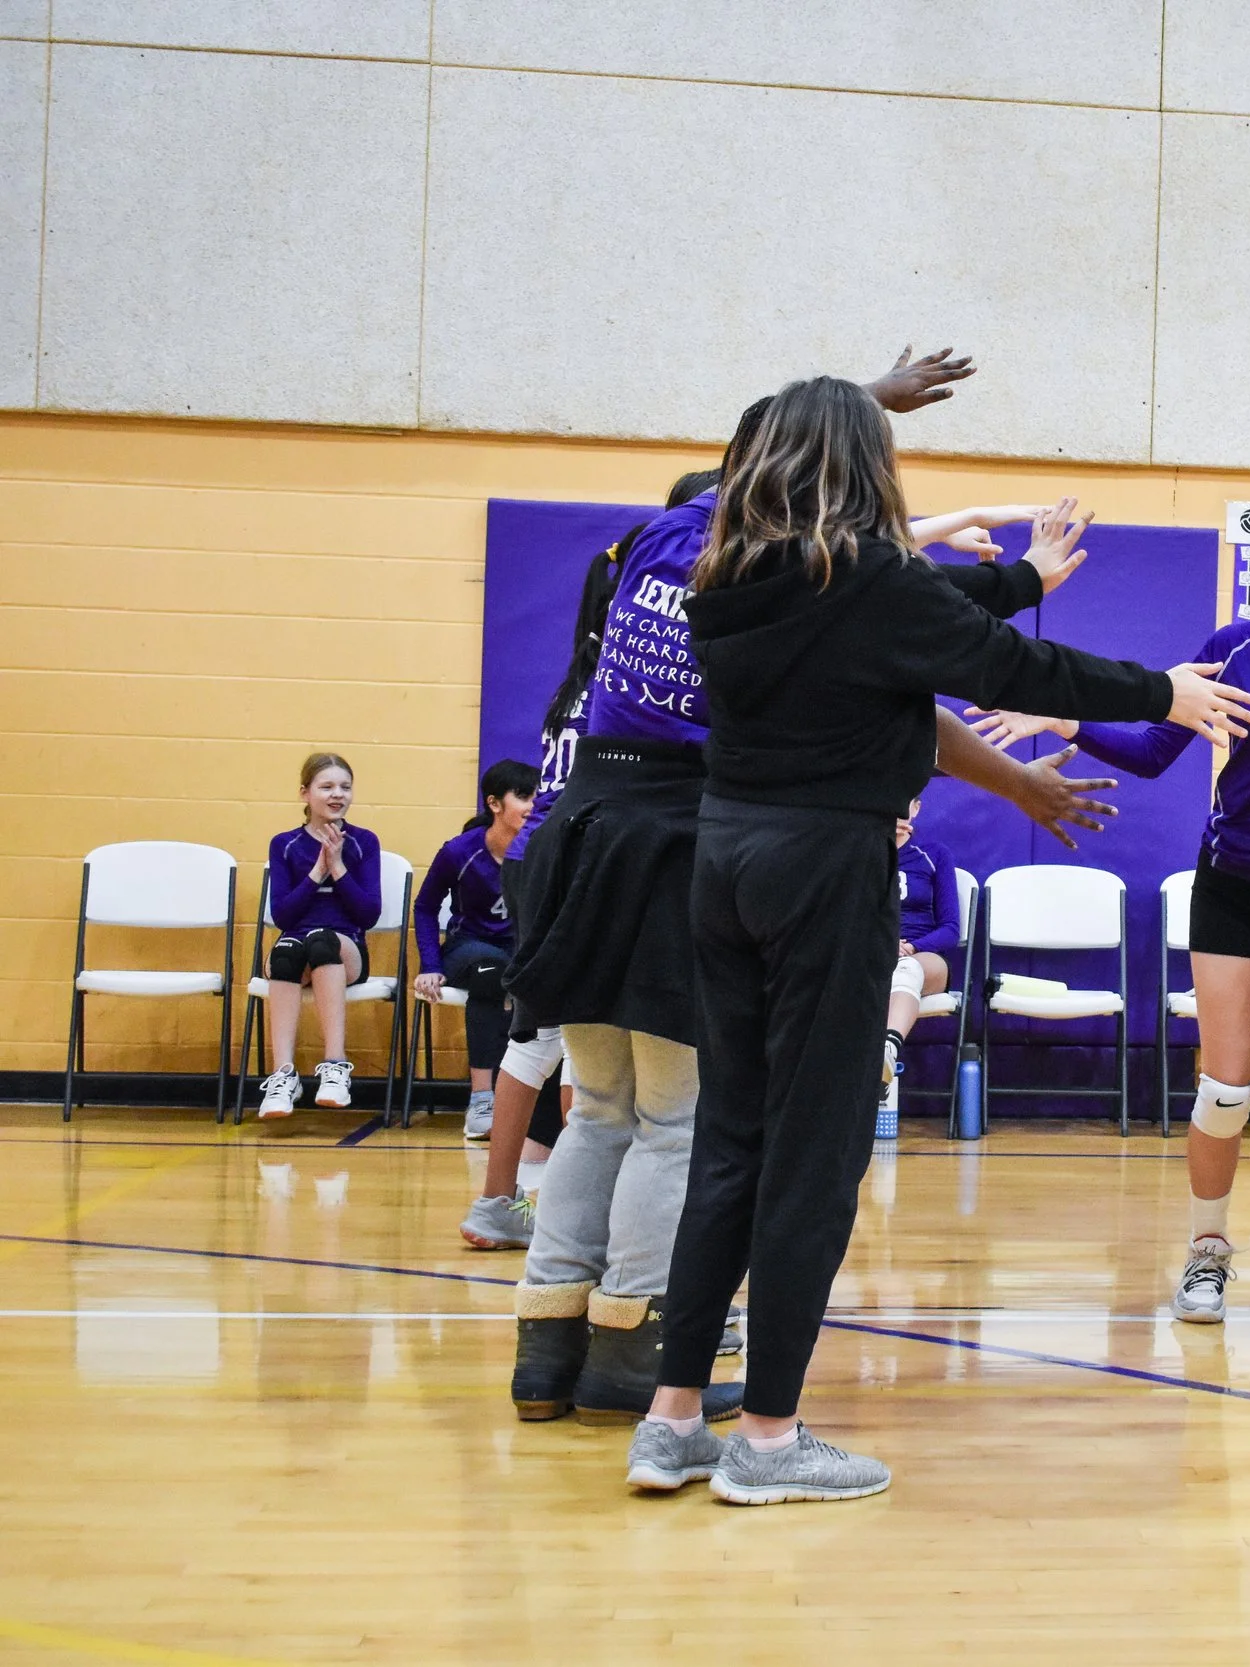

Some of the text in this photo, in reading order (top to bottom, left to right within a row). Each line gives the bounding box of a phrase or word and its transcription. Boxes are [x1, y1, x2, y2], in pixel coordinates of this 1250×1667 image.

[607, 623, 623, 643] WE
[627, 634, 692, 666] HEARD.
[616, 607, 690, 646] WE CAME
[638, 682, 695, 717] ME
[538, 728, 580, 793] 20
